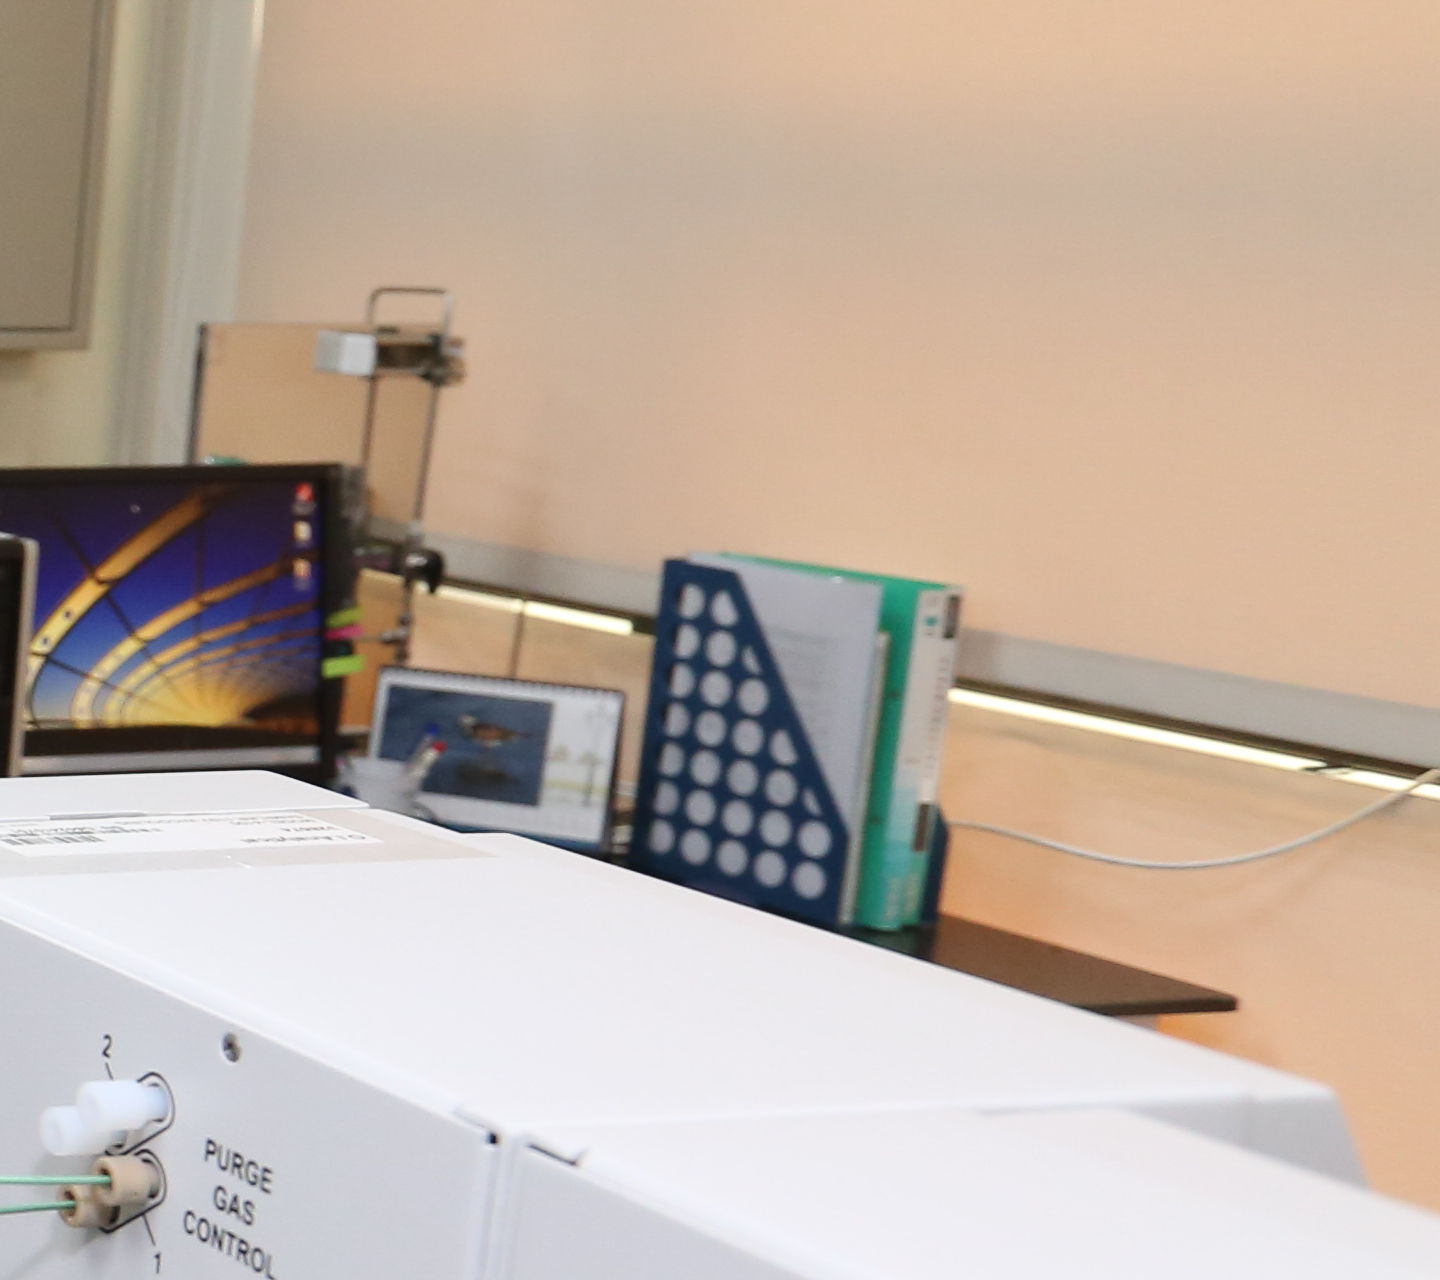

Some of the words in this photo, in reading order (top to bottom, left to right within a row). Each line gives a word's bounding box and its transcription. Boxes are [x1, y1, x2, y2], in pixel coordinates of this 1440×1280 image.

[102, 1034, 112, 1058] 2
[204, 1137, 274, 1194] PURGE
[213, 1185, 255, 1226] GAS
[154, 1252, 162, 1274] 1
